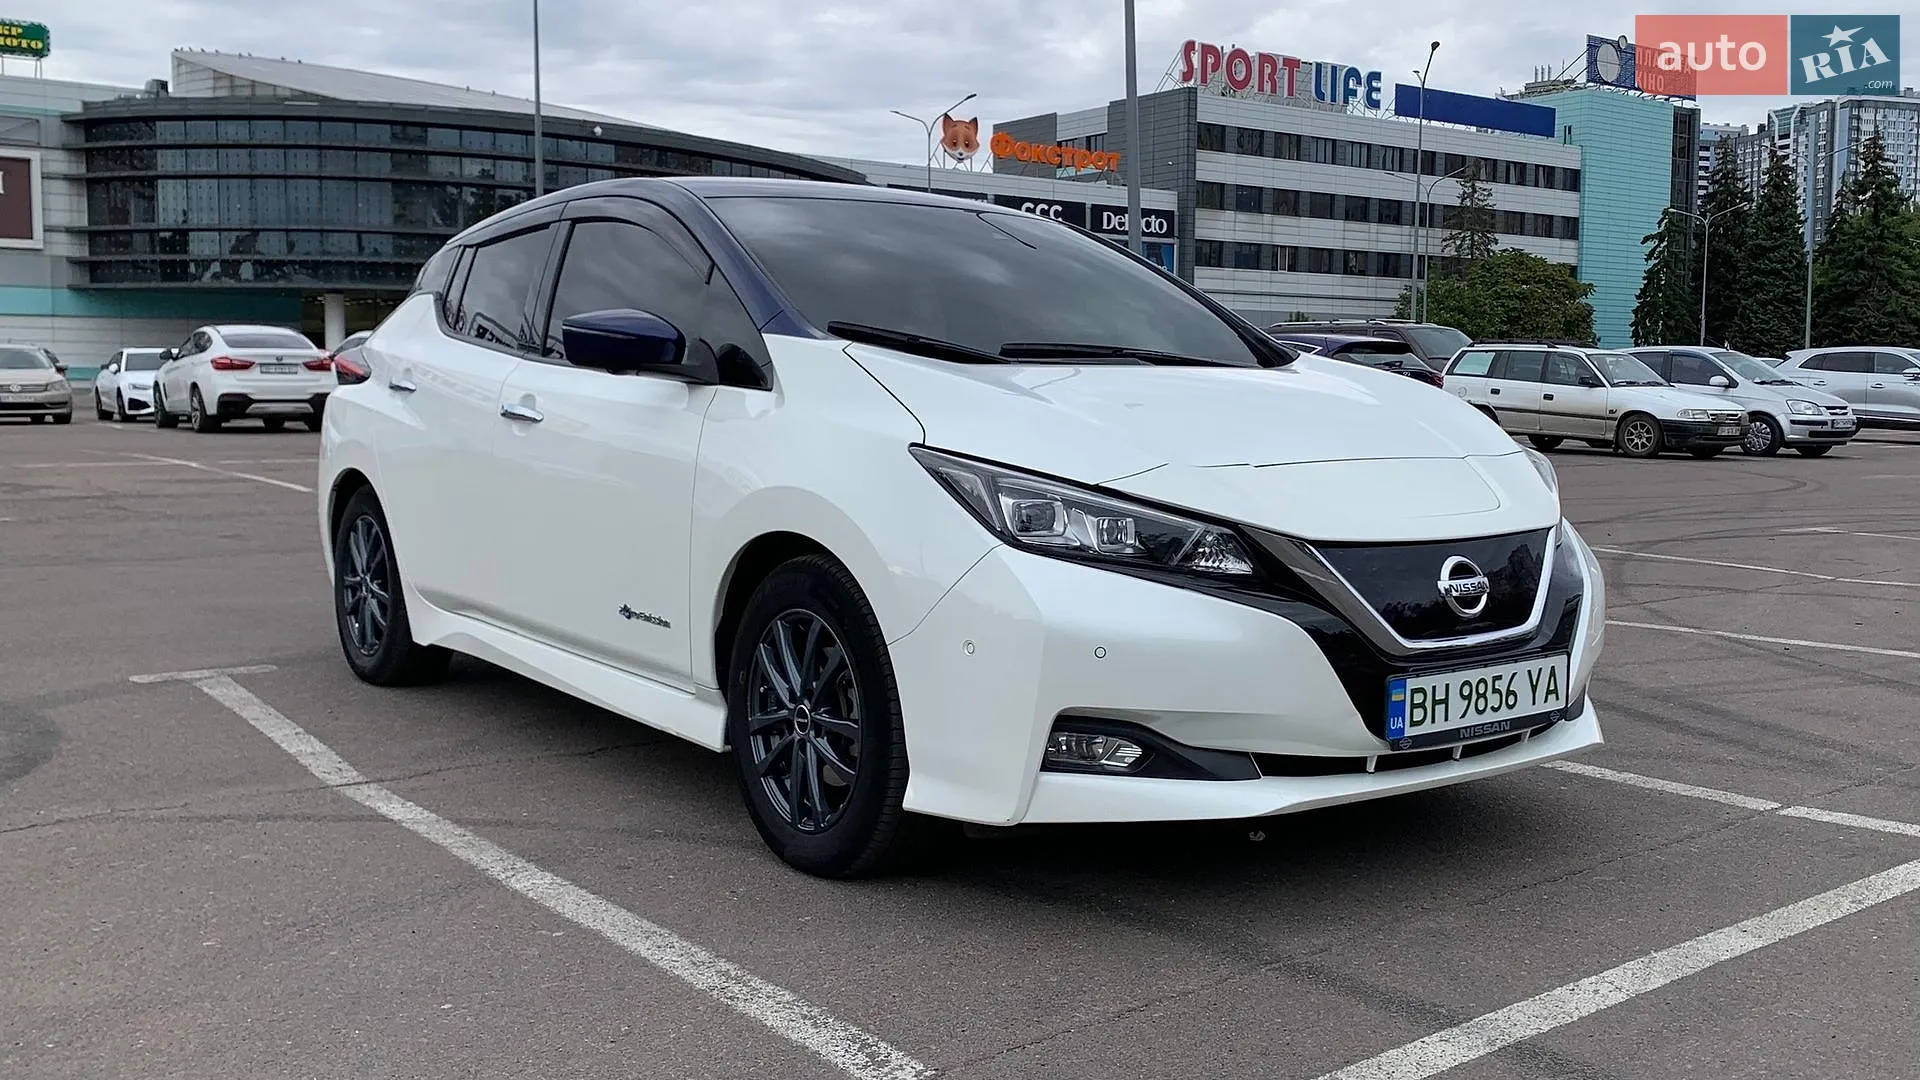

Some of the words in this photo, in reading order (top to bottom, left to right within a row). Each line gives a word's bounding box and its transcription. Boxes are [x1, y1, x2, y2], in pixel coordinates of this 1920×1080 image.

[1636, 47, 1692, 75] ПЛАА
[1180, 39, 1301, 98] SPORT
[1312, 61, 1383, 111] LIFE
[990, 131, 1121, 172] Фокстрот
[1102, 211, 1168, 234] Decto
[1448, 580, 1489, 593] NISSAN
[1409, 682, 1450, 728] BH
[1459, 671, 1519, 719] 9856
[1527, 665, 1561, 706] YA
[1390, 716, 1404, 730] UA
[1459, 720, 1511, 739] NISSAN
